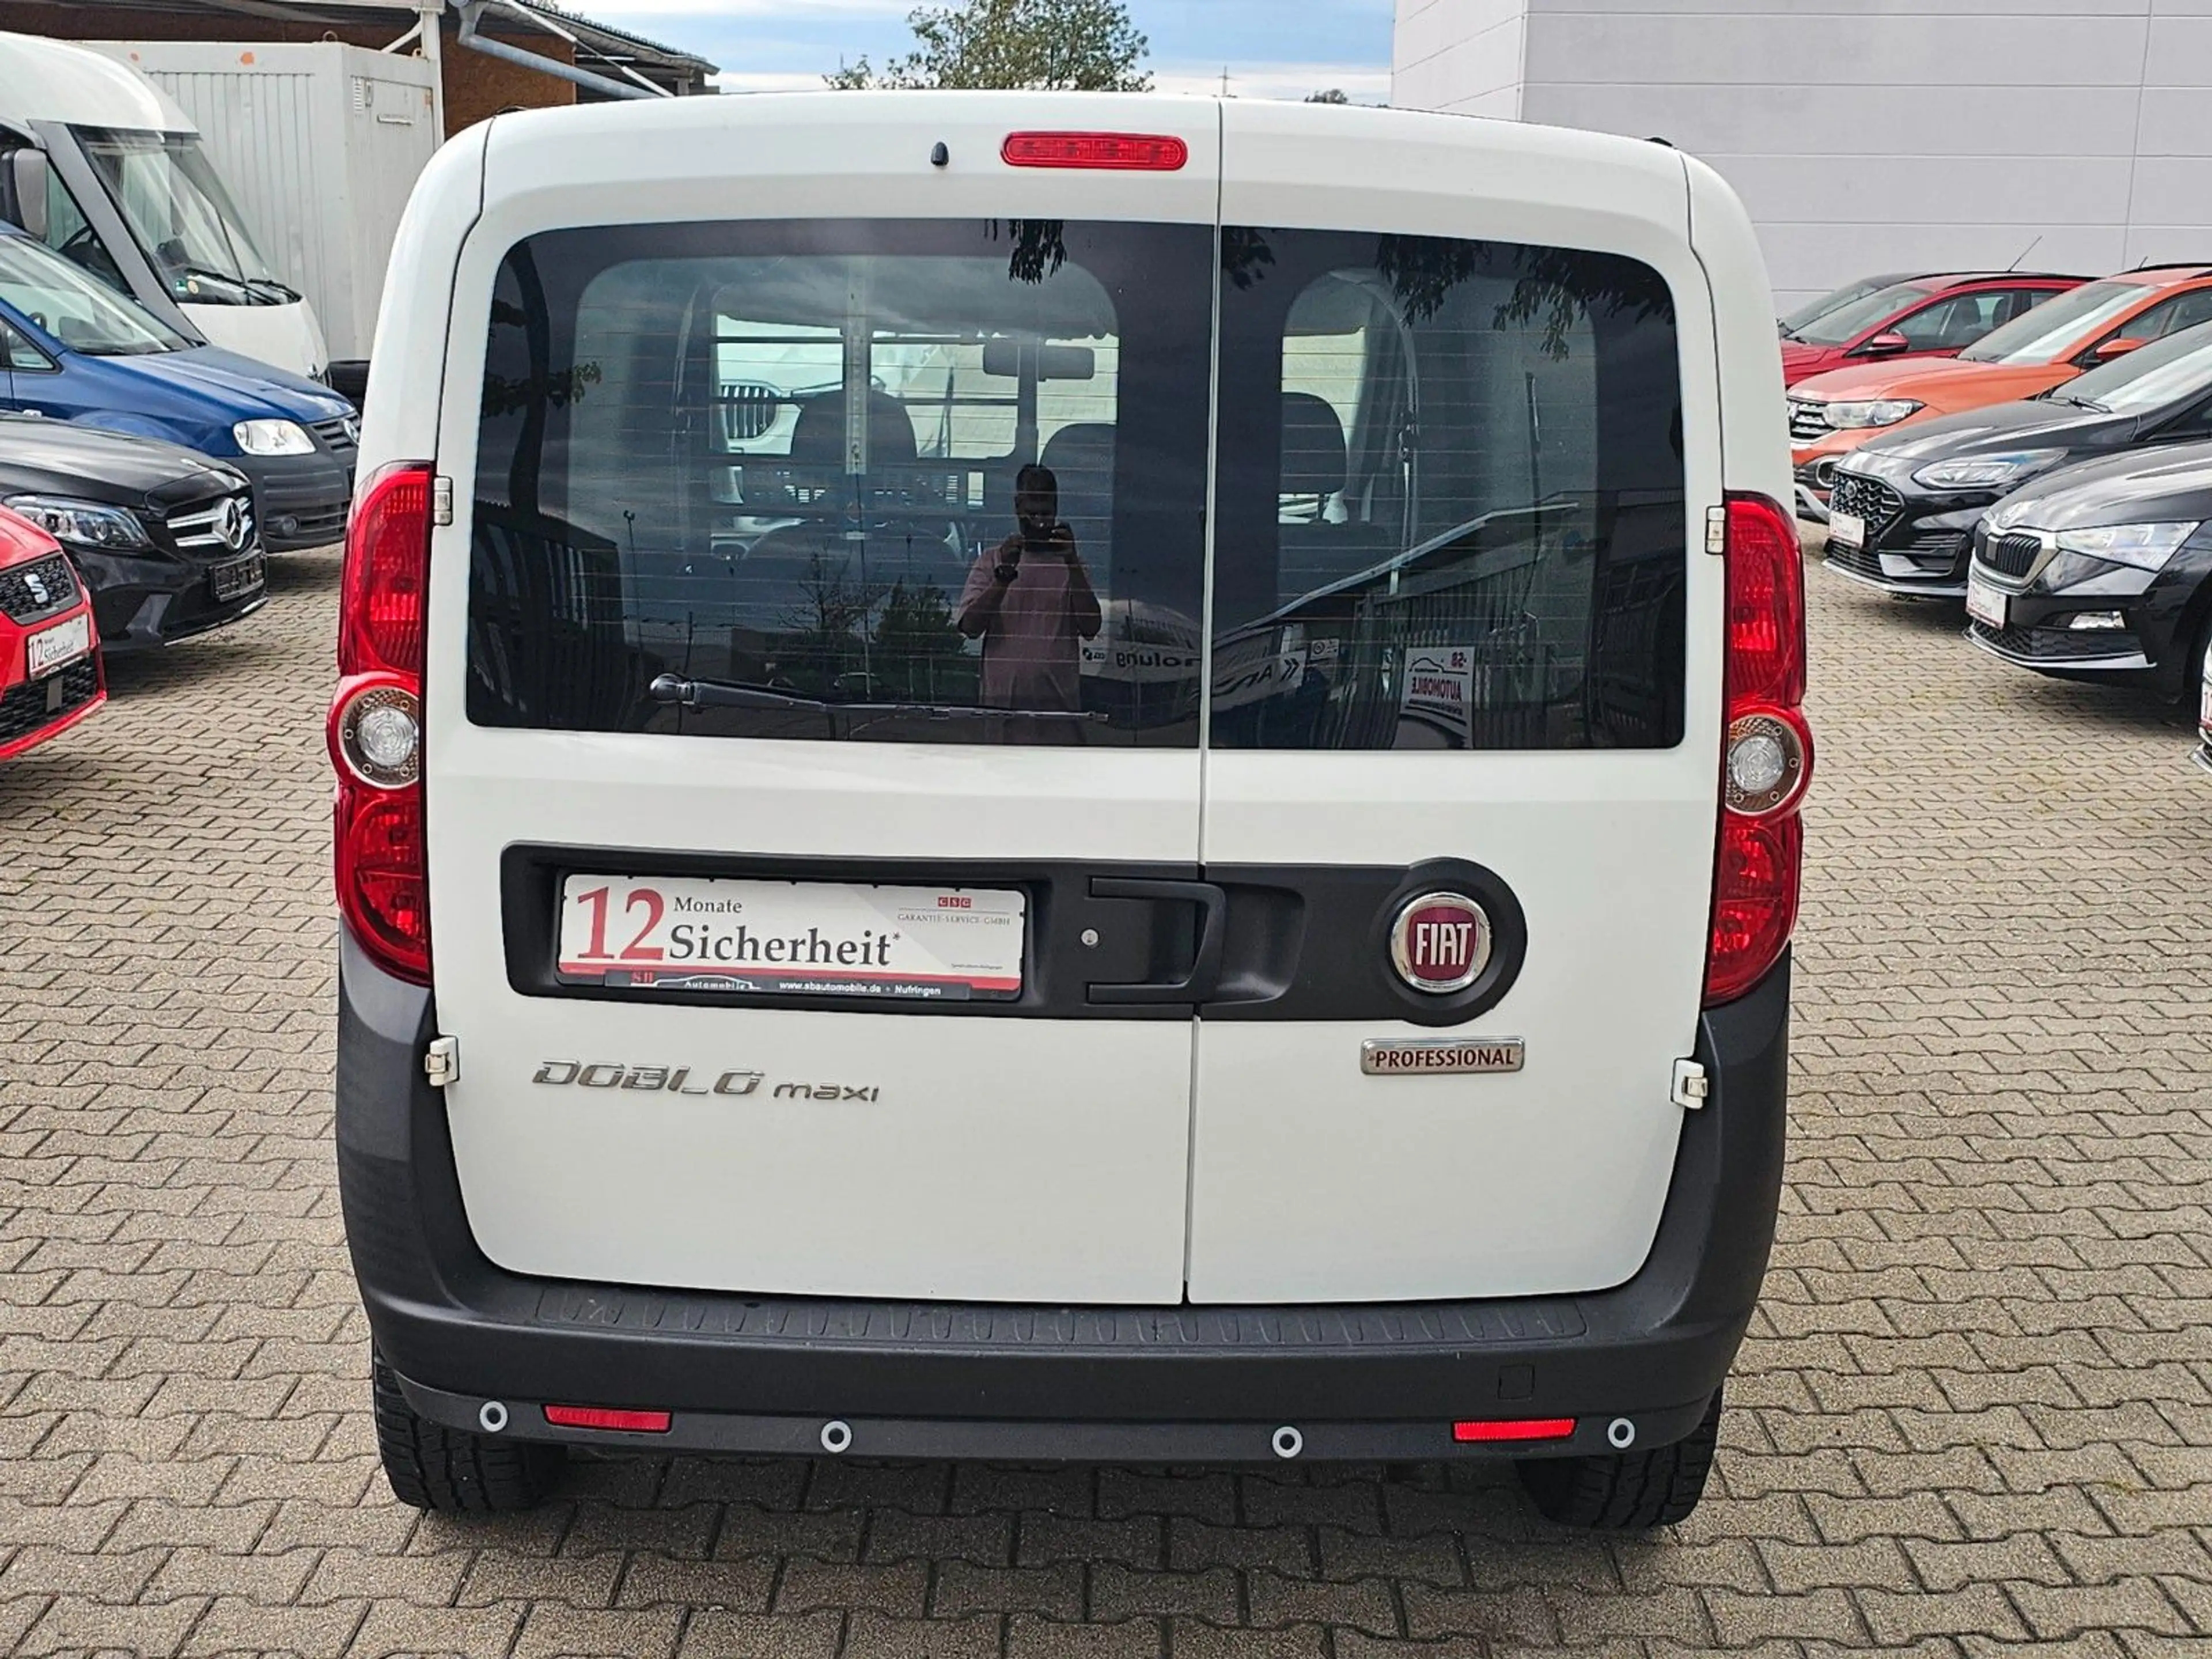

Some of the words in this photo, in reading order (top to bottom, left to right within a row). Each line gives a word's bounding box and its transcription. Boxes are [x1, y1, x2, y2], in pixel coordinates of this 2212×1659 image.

[673, 896, 742, 914] Monate
[577, 886, 664, 960] 12
[1415, 923, 1472, 965] FIAT
[894, 984, 941, 997] Nufringen
[1375, 1048, 1514, 1067] PROFESSIONAL
